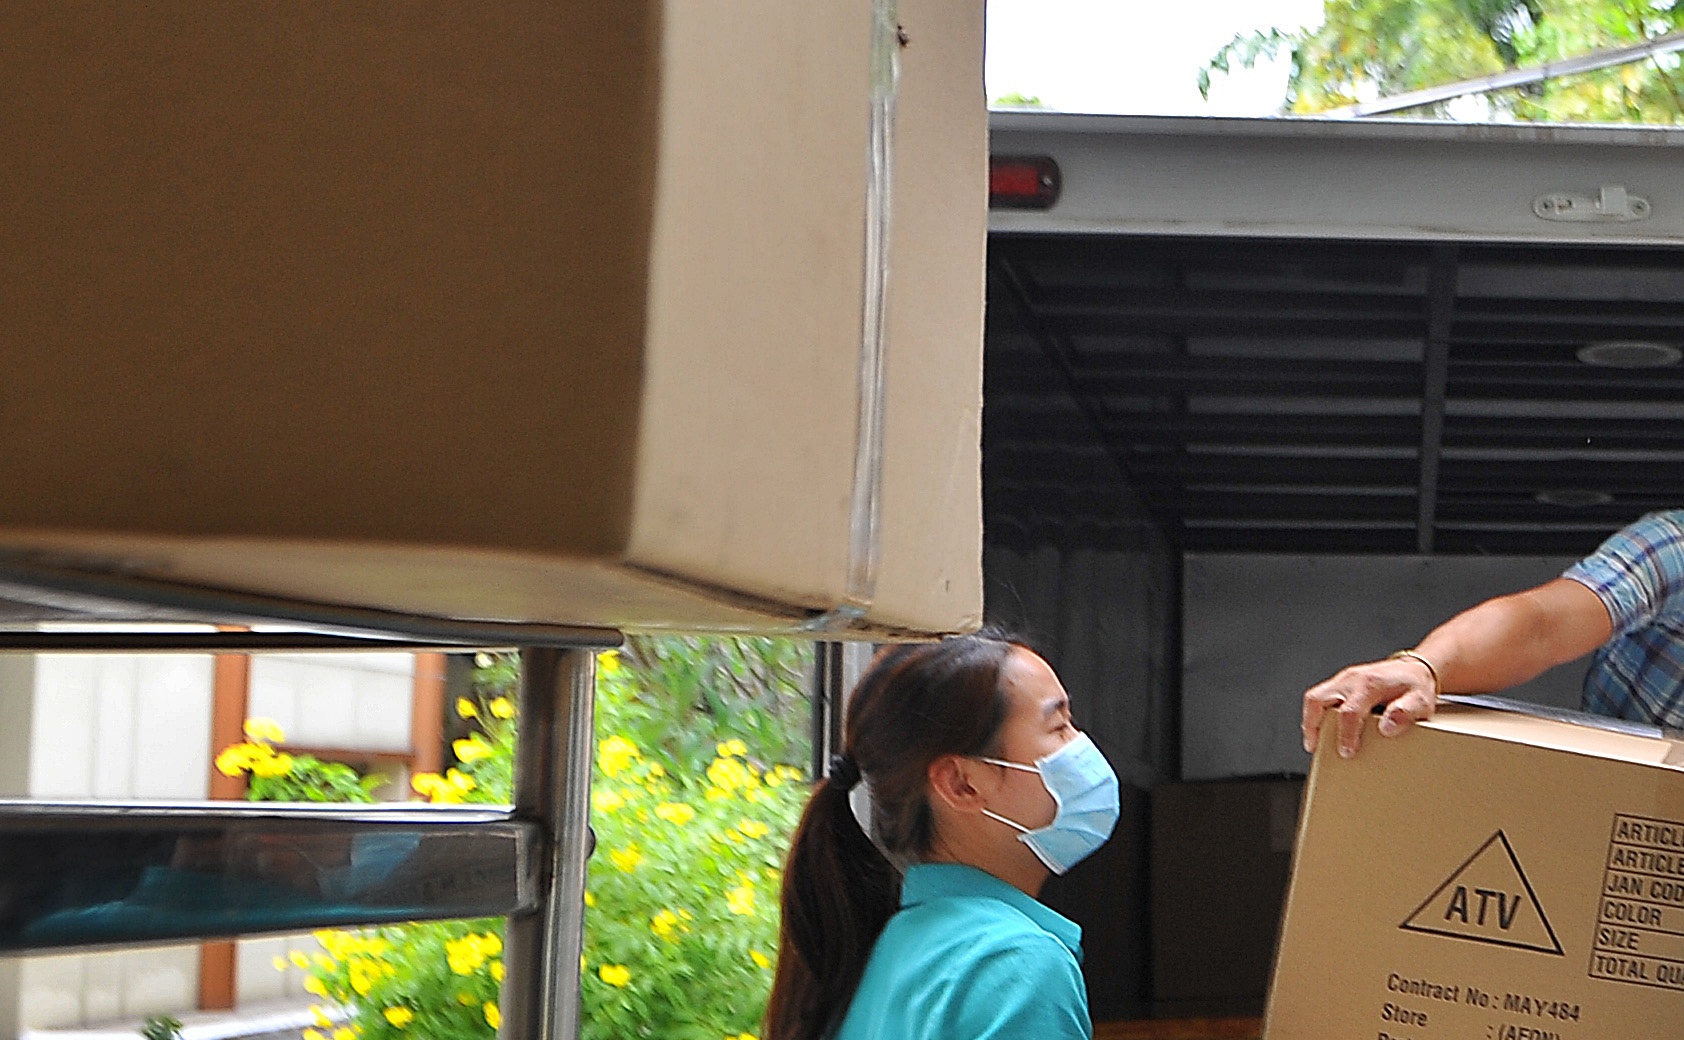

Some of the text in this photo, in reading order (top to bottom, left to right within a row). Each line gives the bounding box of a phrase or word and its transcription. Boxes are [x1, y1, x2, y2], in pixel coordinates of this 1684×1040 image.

[1607, 874, 1642, 897] JAN
[1444, 886, 1521, 930] ATV
[1604, 901, 1662, 927] COLOR
[1599, 928, 1640, 950] SIZE
[1595, 955, 1647, 980] TOTAL
[1387, 973, 1459, 1002] Contract
[1381, 1002, 1428, 1027] Store
